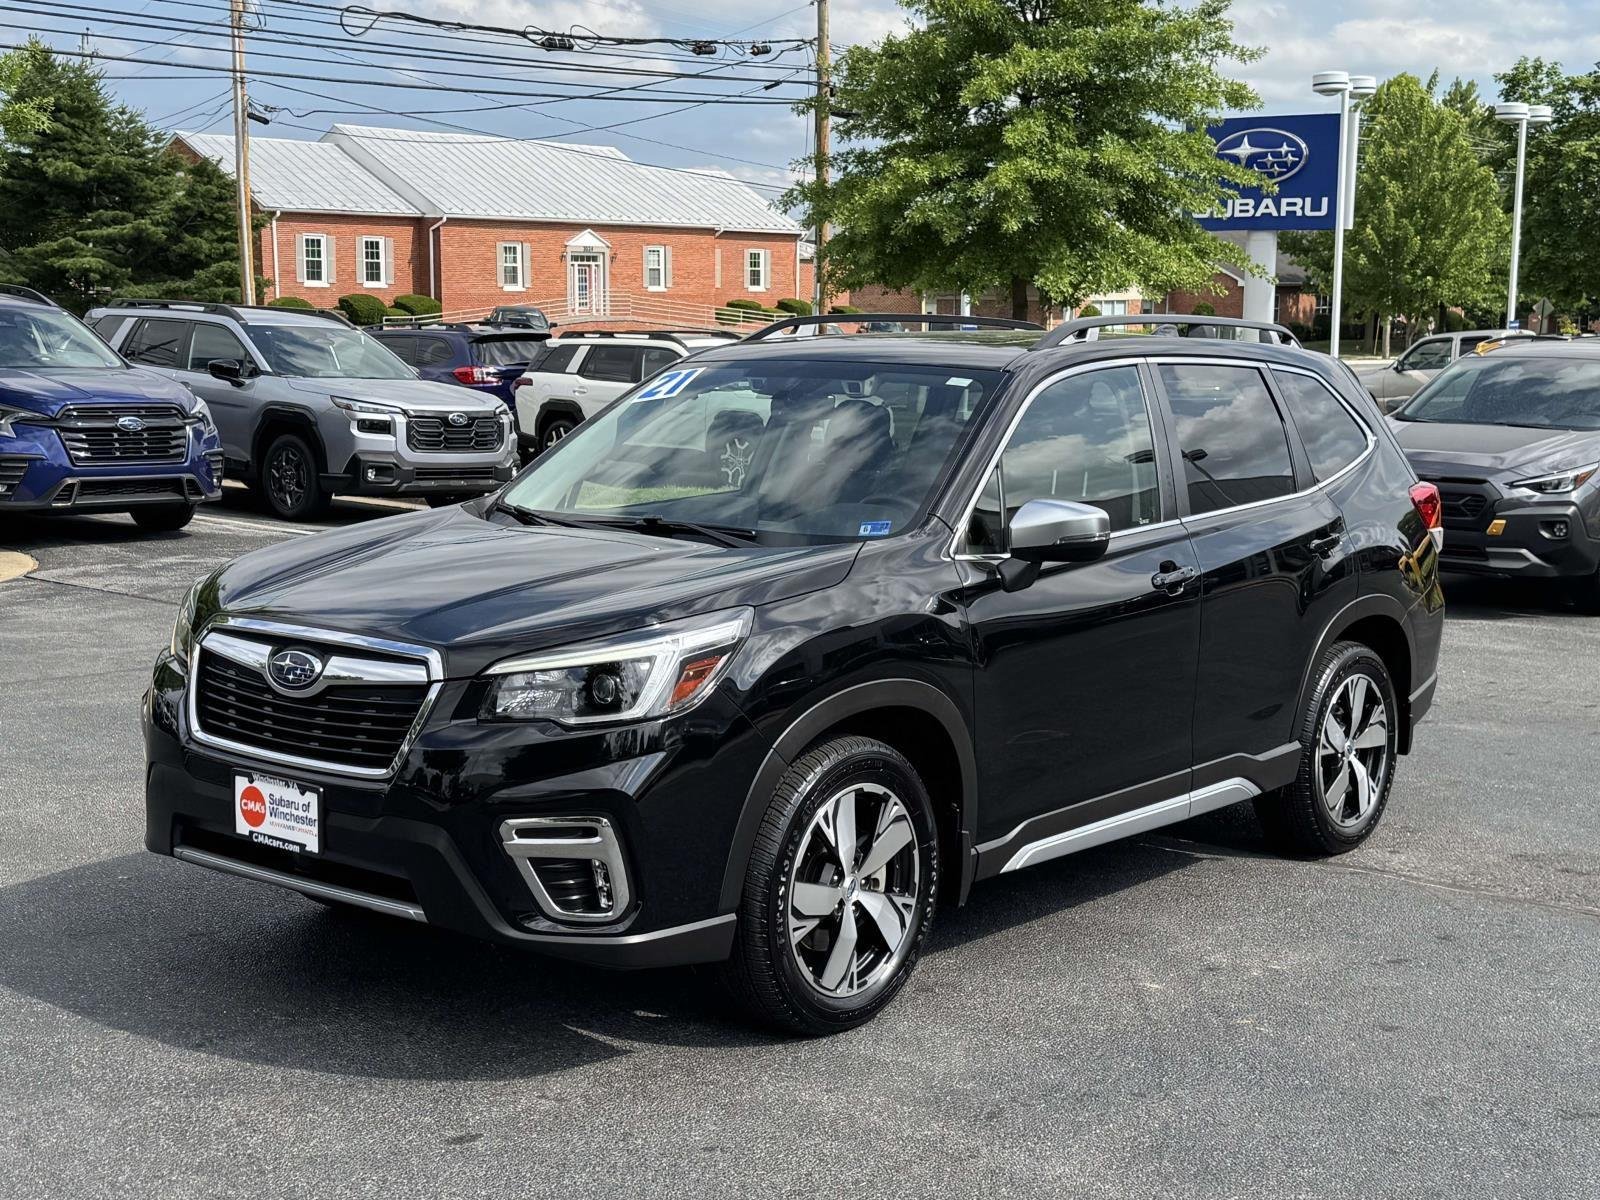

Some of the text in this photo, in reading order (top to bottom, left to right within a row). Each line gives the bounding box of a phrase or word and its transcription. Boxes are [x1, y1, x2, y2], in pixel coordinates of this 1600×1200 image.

[637, 369, 698, 399] 21
[268, 793, 311, 814] Subaru of
[268, 806, 318, 827] Winchester
[253, 832, 300, 853] CMAcars.com
